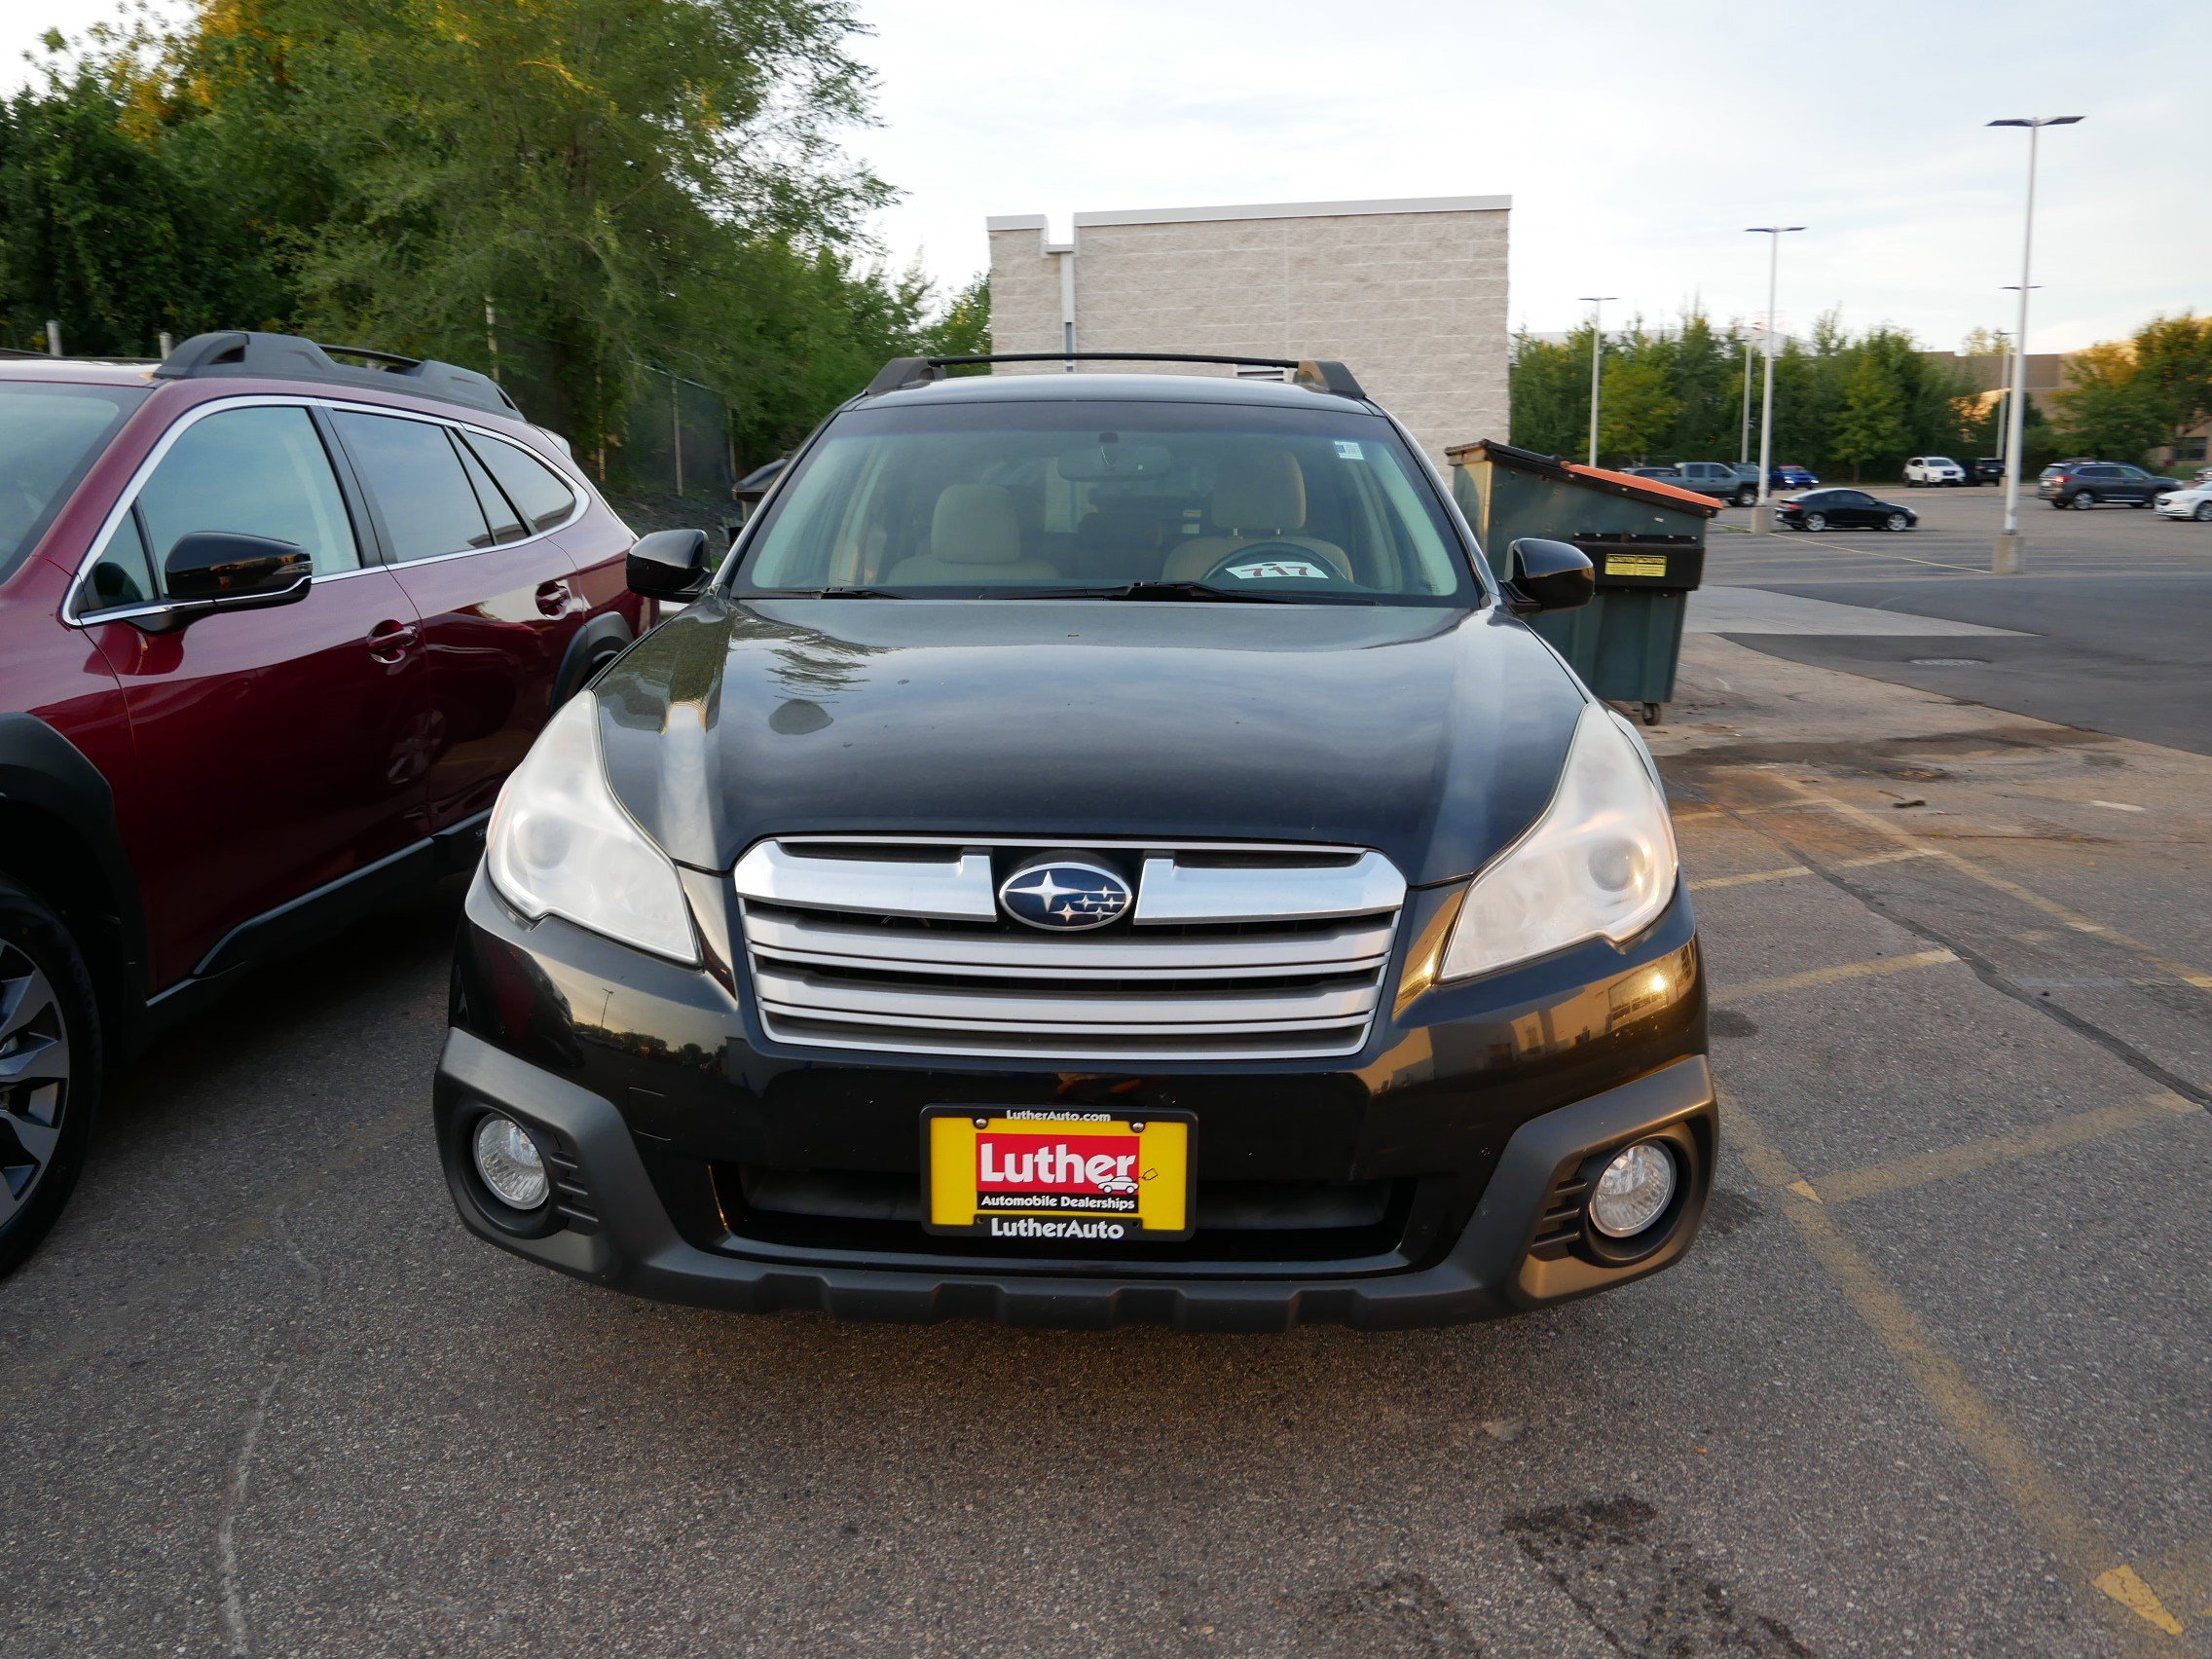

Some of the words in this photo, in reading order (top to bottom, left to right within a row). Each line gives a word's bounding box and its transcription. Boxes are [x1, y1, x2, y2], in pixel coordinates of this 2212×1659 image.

[1240, 566, 1309, 577] 717
[1006, 1109, 1112, 1123] LutherAuto.com
[980, 1142, 1137, 1184] Luther
[980, 1195, 1058, 1208] Automobile
[1060, 1196, 1135, 1211] Dealerships
[991, 1217, 1124, 1239] LutherAuto
